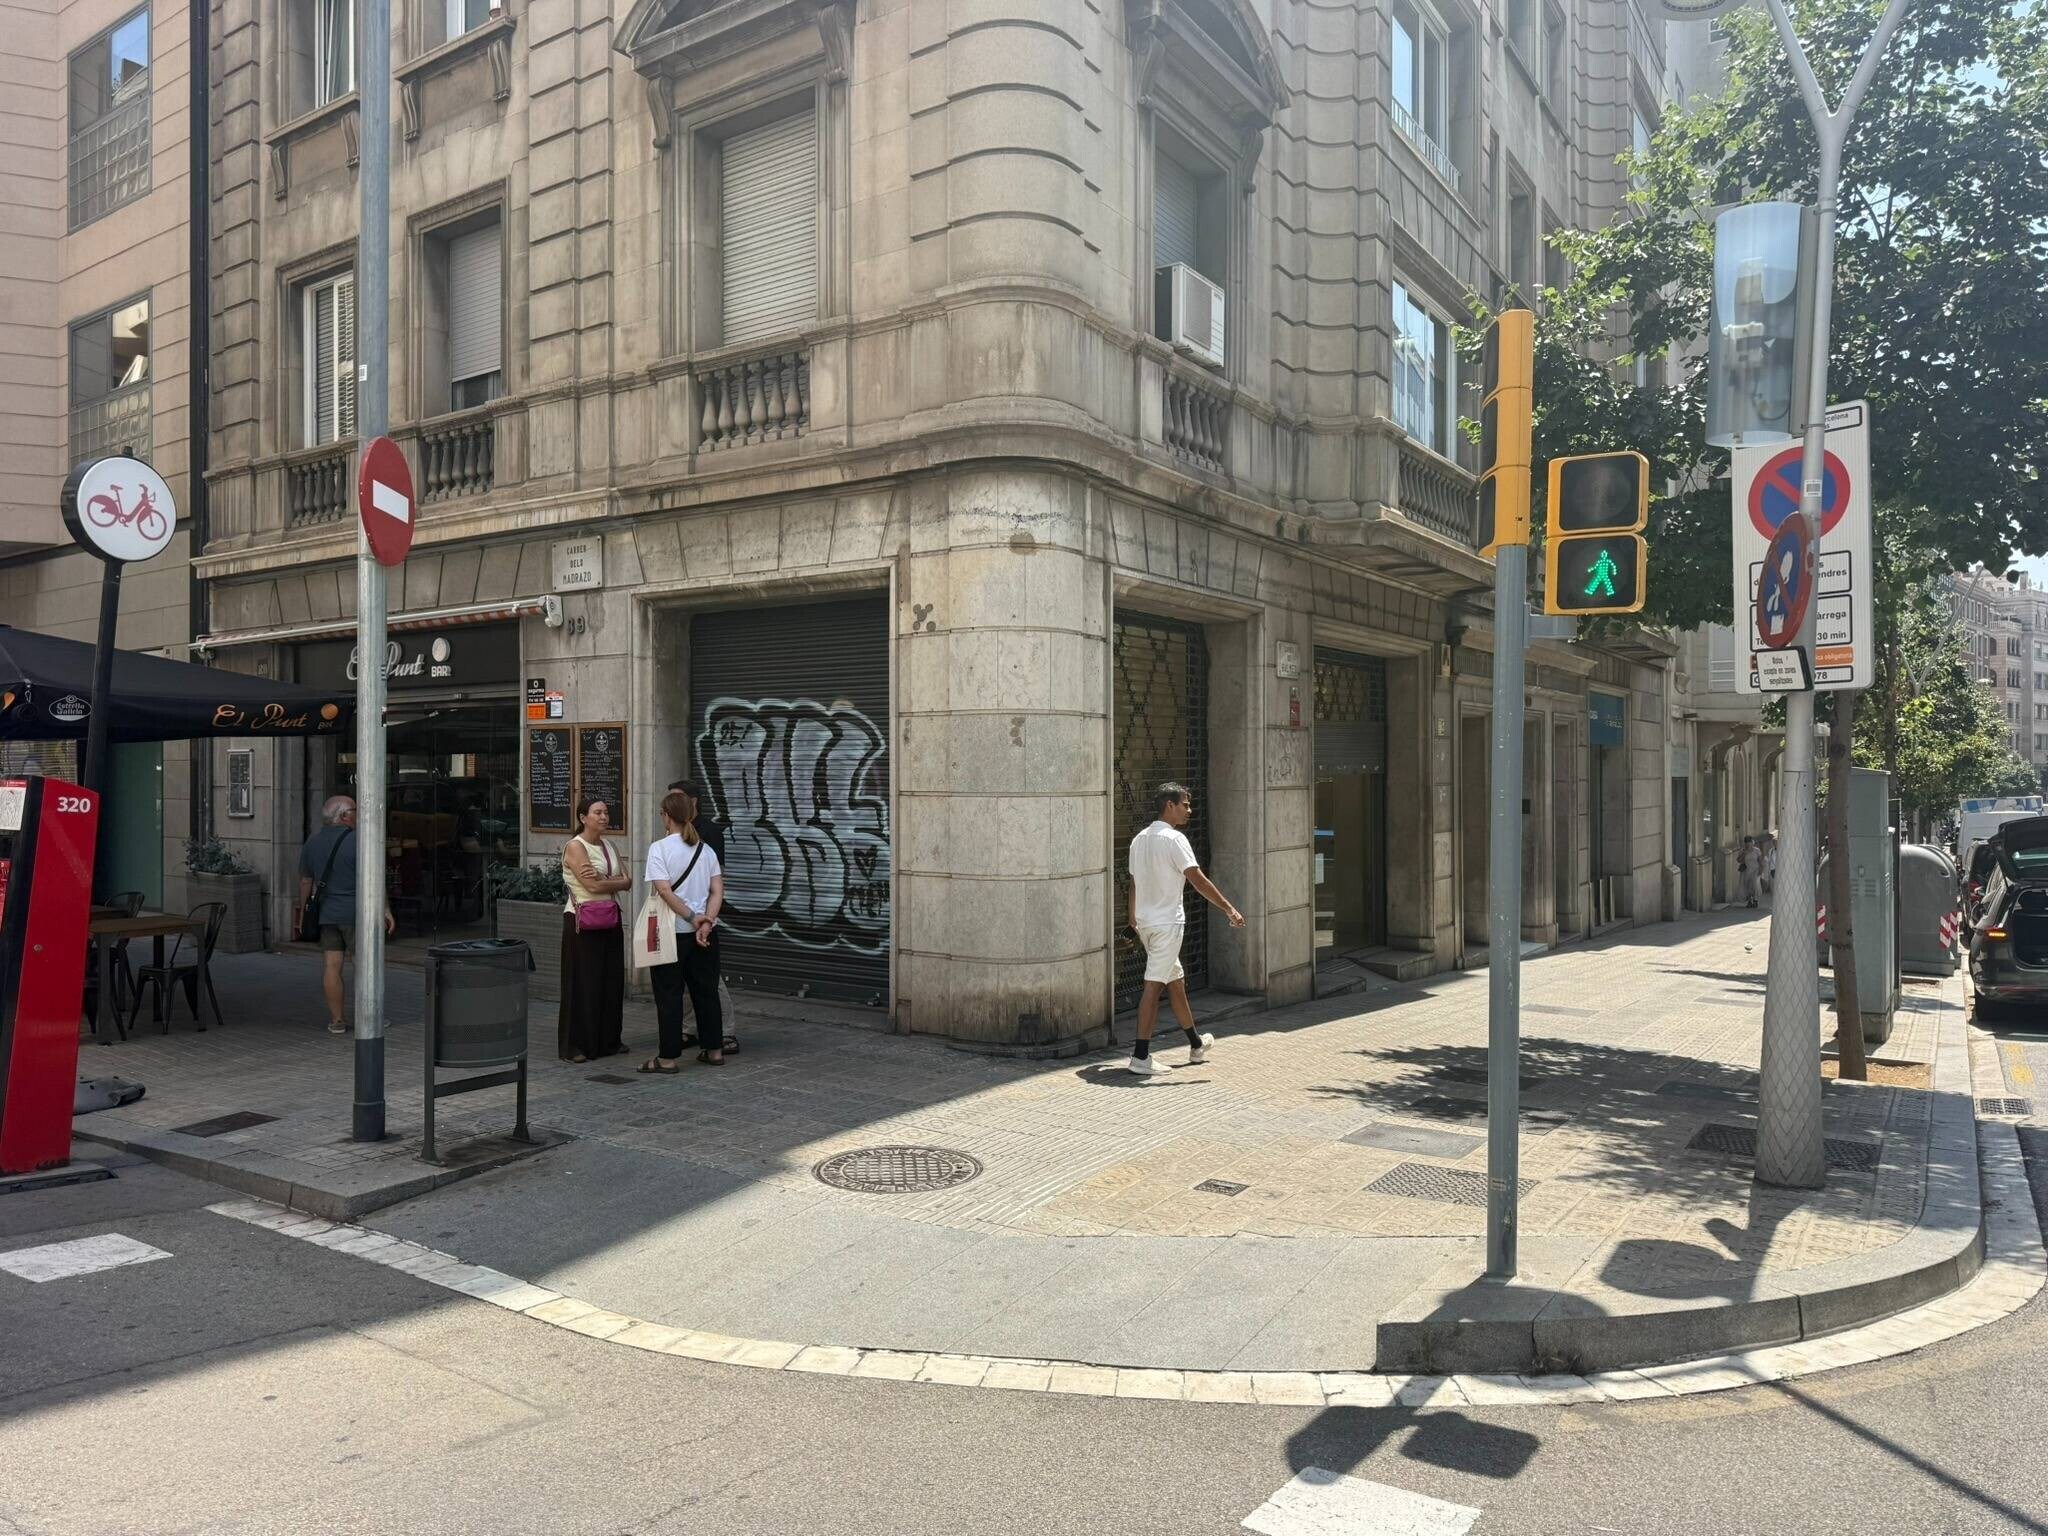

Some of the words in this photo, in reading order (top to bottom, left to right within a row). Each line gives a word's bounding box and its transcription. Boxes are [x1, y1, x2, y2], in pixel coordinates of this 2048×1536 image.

[1825, 412, 1849, 423] rcelona
[566, 544, 587, 555] CARRER
[563, 571, 592, 585] MADRAZO
[1816, 611, 1847, 620] àrrega
[1817, 632, 1828, 641] 30
[1830, 630, 1847, 639] min
[431, 665, 451, 678] BAR
[212, 704, 245, 727] El
[250, 703, 308, 729] Punt
[57, 796, 91, 813] 320
